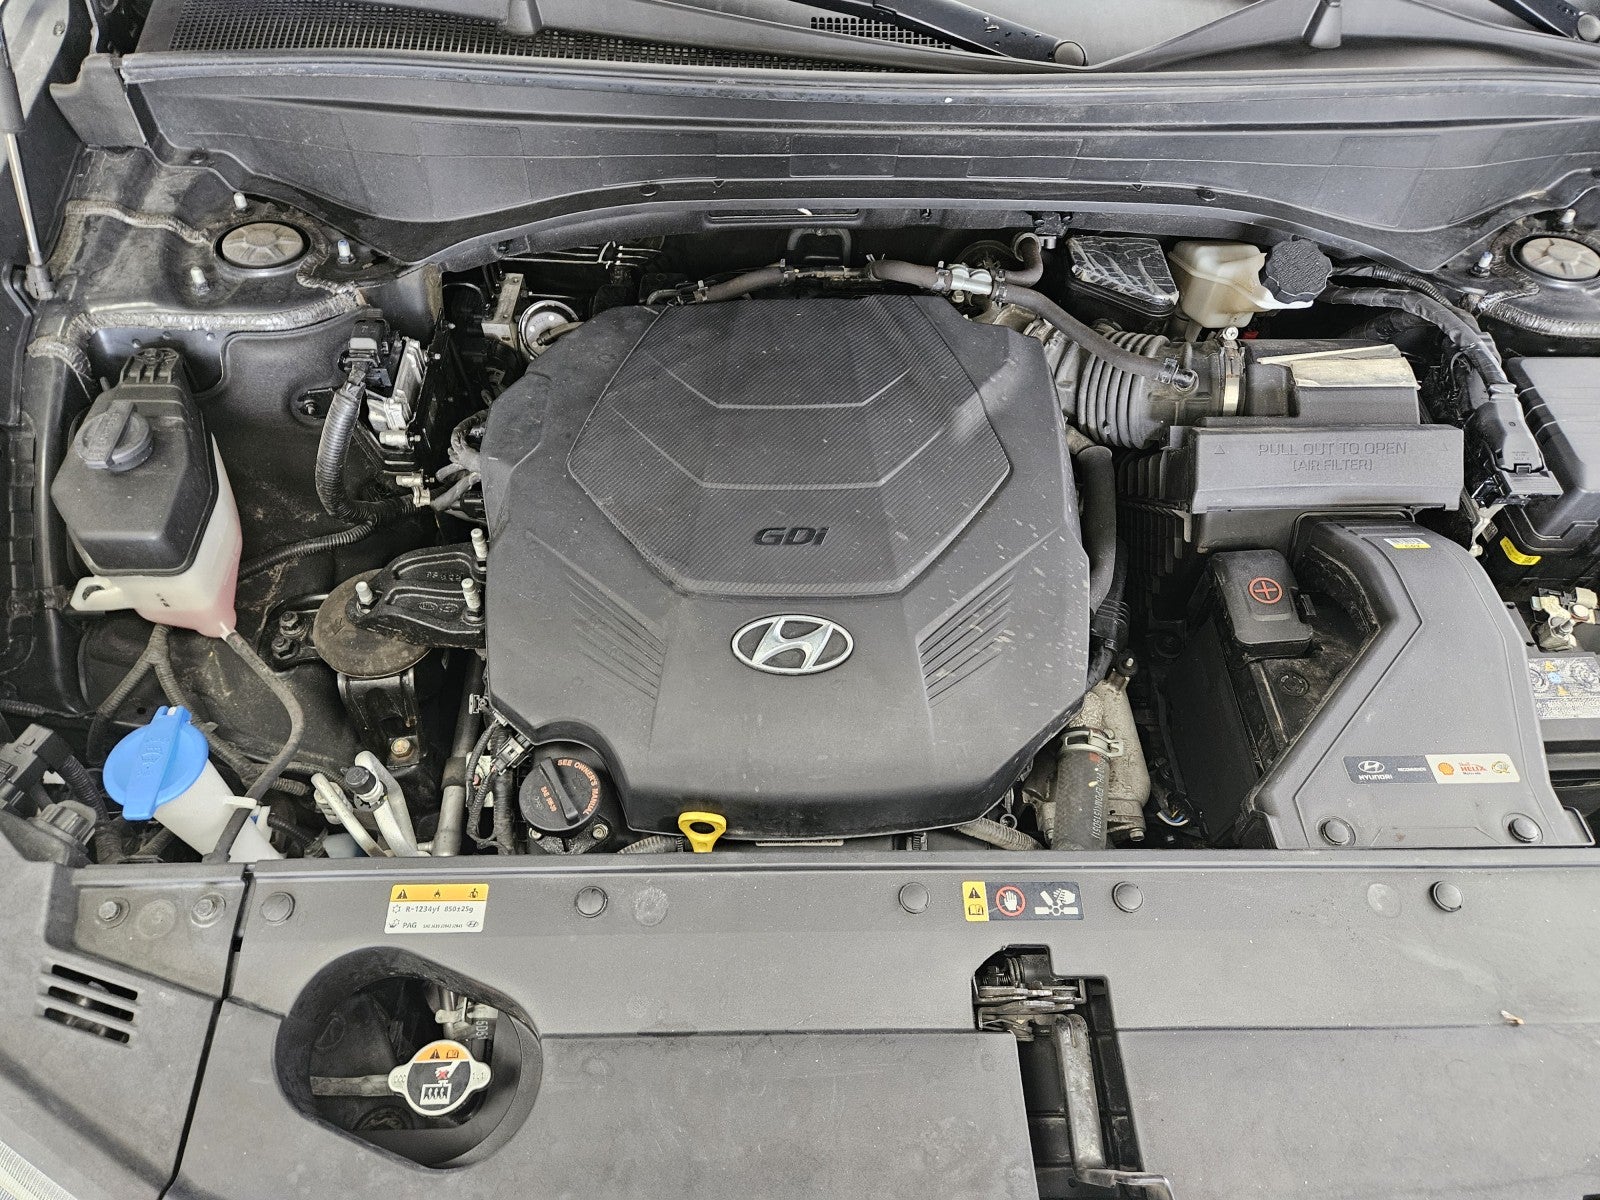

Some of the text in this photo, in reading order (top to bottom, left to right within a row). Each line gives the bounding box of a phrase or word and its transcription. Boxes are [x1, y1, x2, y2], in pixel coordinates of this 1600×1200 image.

[1258, 442, 1407, 456] PULL OUT TO OPEN
[754, 527, 830, 546] GDi
[557, 759, 573, 767] SEE
[583, 788, 599, 815] MANUAL
[405, 904, 440, 914] R-1234yf
[402, 921, 417, 929] PAG
